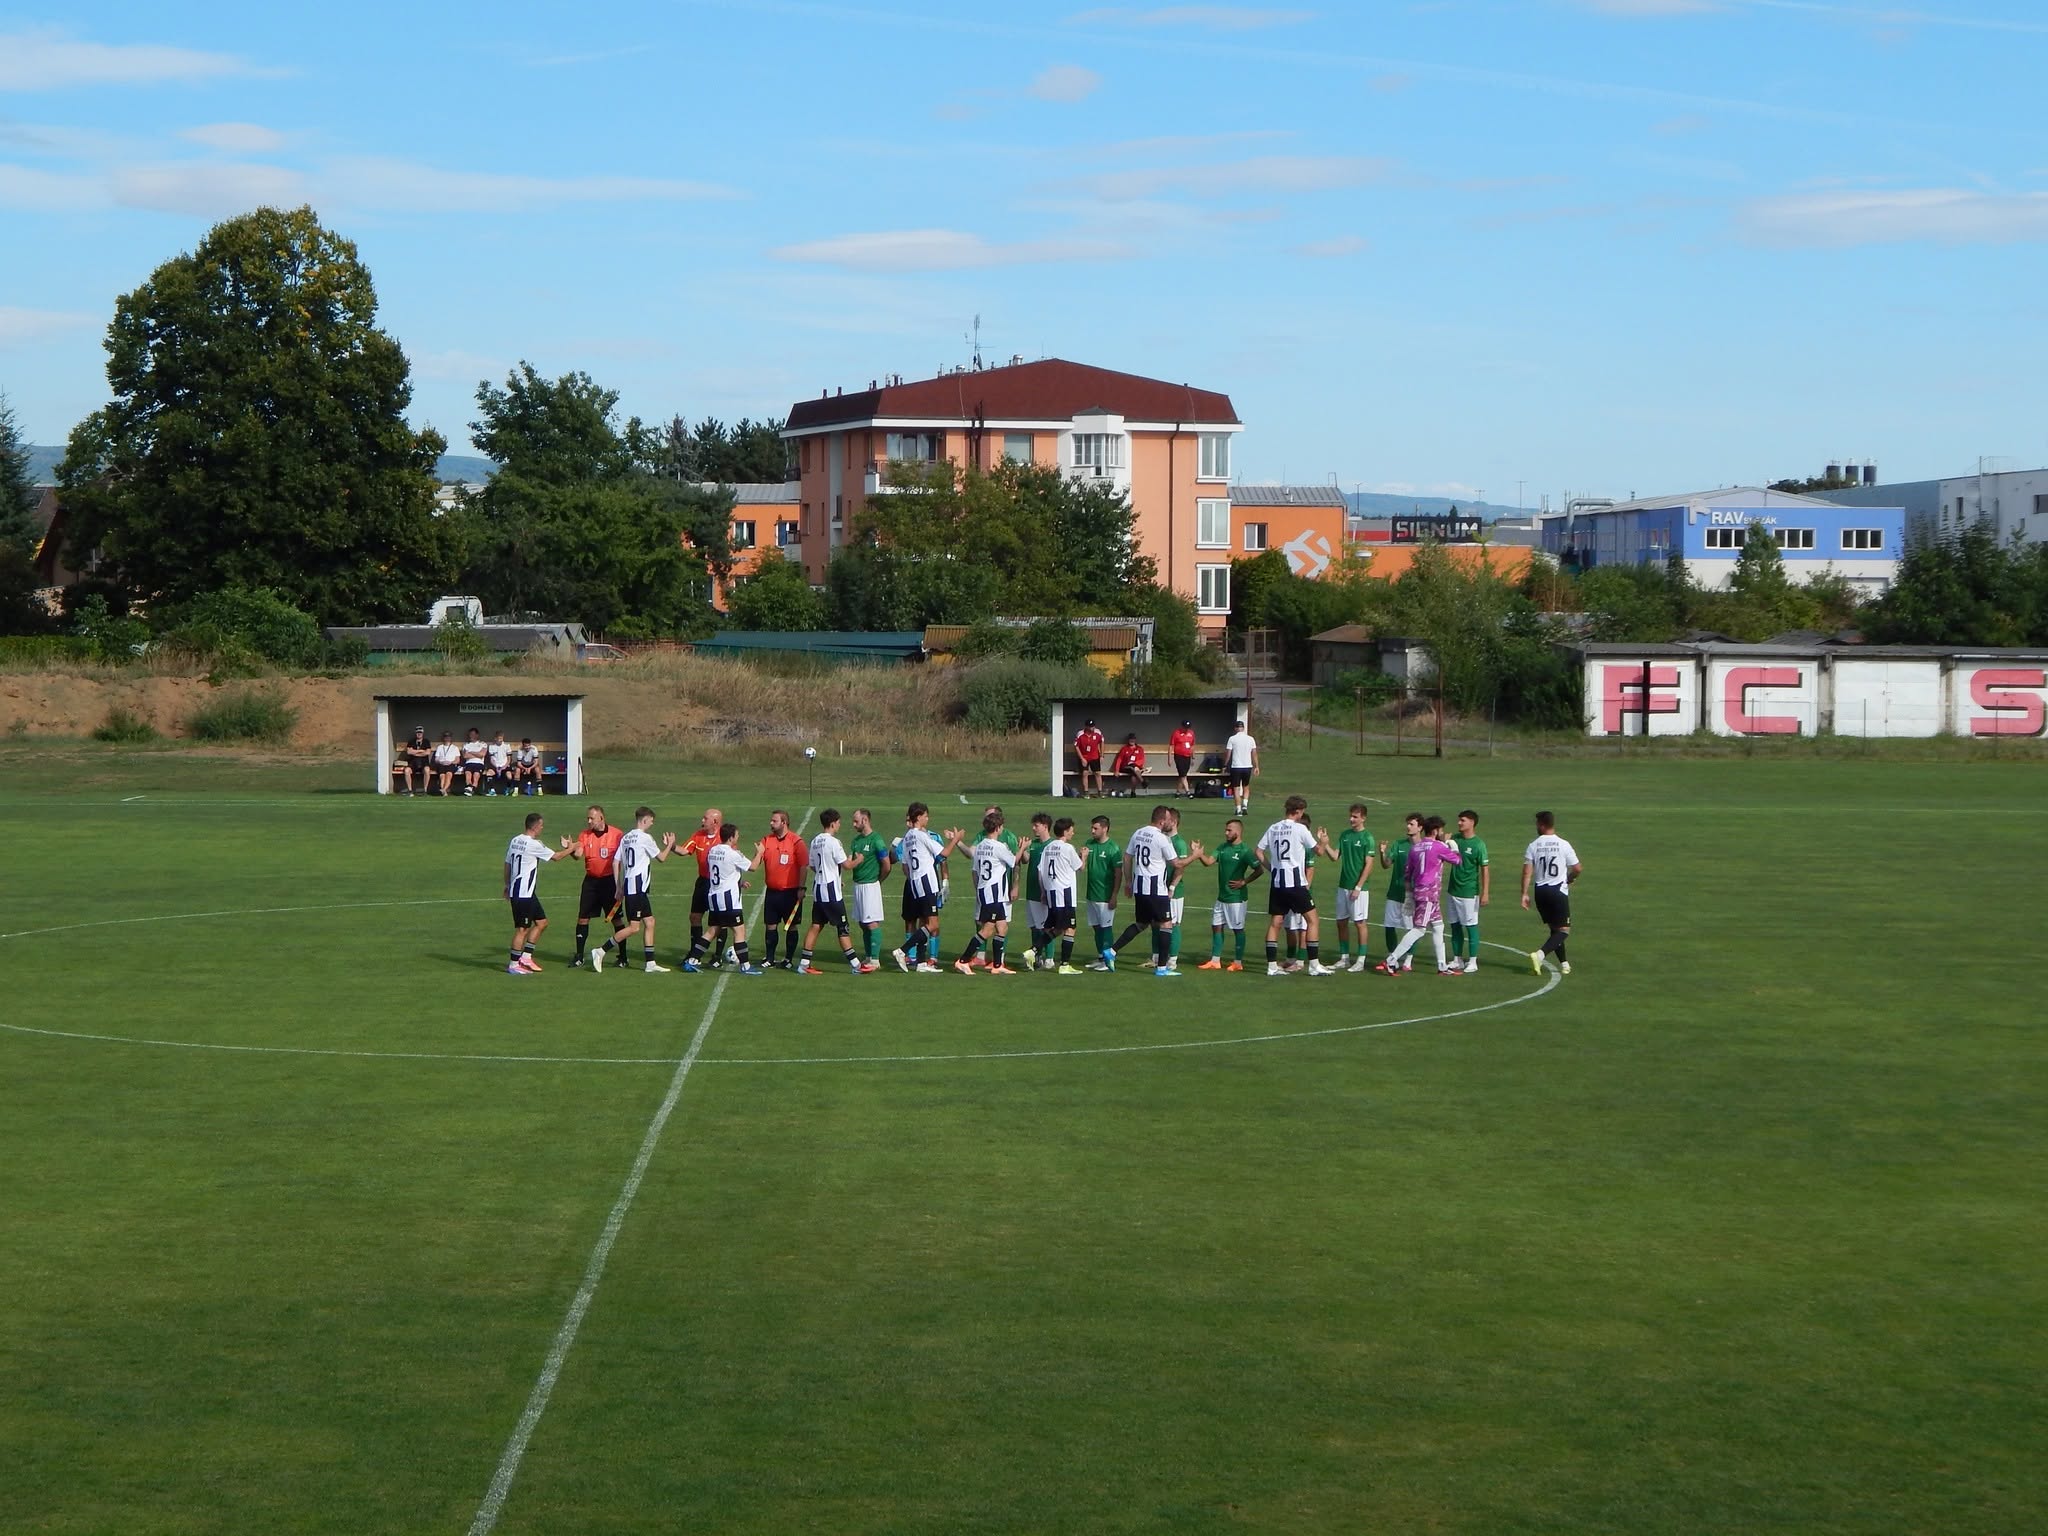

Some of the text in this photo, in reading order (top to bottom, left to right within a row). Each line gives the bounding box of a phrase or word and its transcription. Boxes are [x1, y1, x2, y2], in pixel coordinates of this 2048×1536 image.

[1711, 511, 1744, 525] RAV
[625, 846, 635, 869] 10
[1135, 844, 1151, 867] 18
[1273, 839, 1291, 861] 12
[510, 853, 522, 876] 11
[711, 864, 720, 886] 3
[978, 859, 992, 881] 13
[1048, 859, 1057, 880] 4
[1539, 856, 1559, 878] 16
